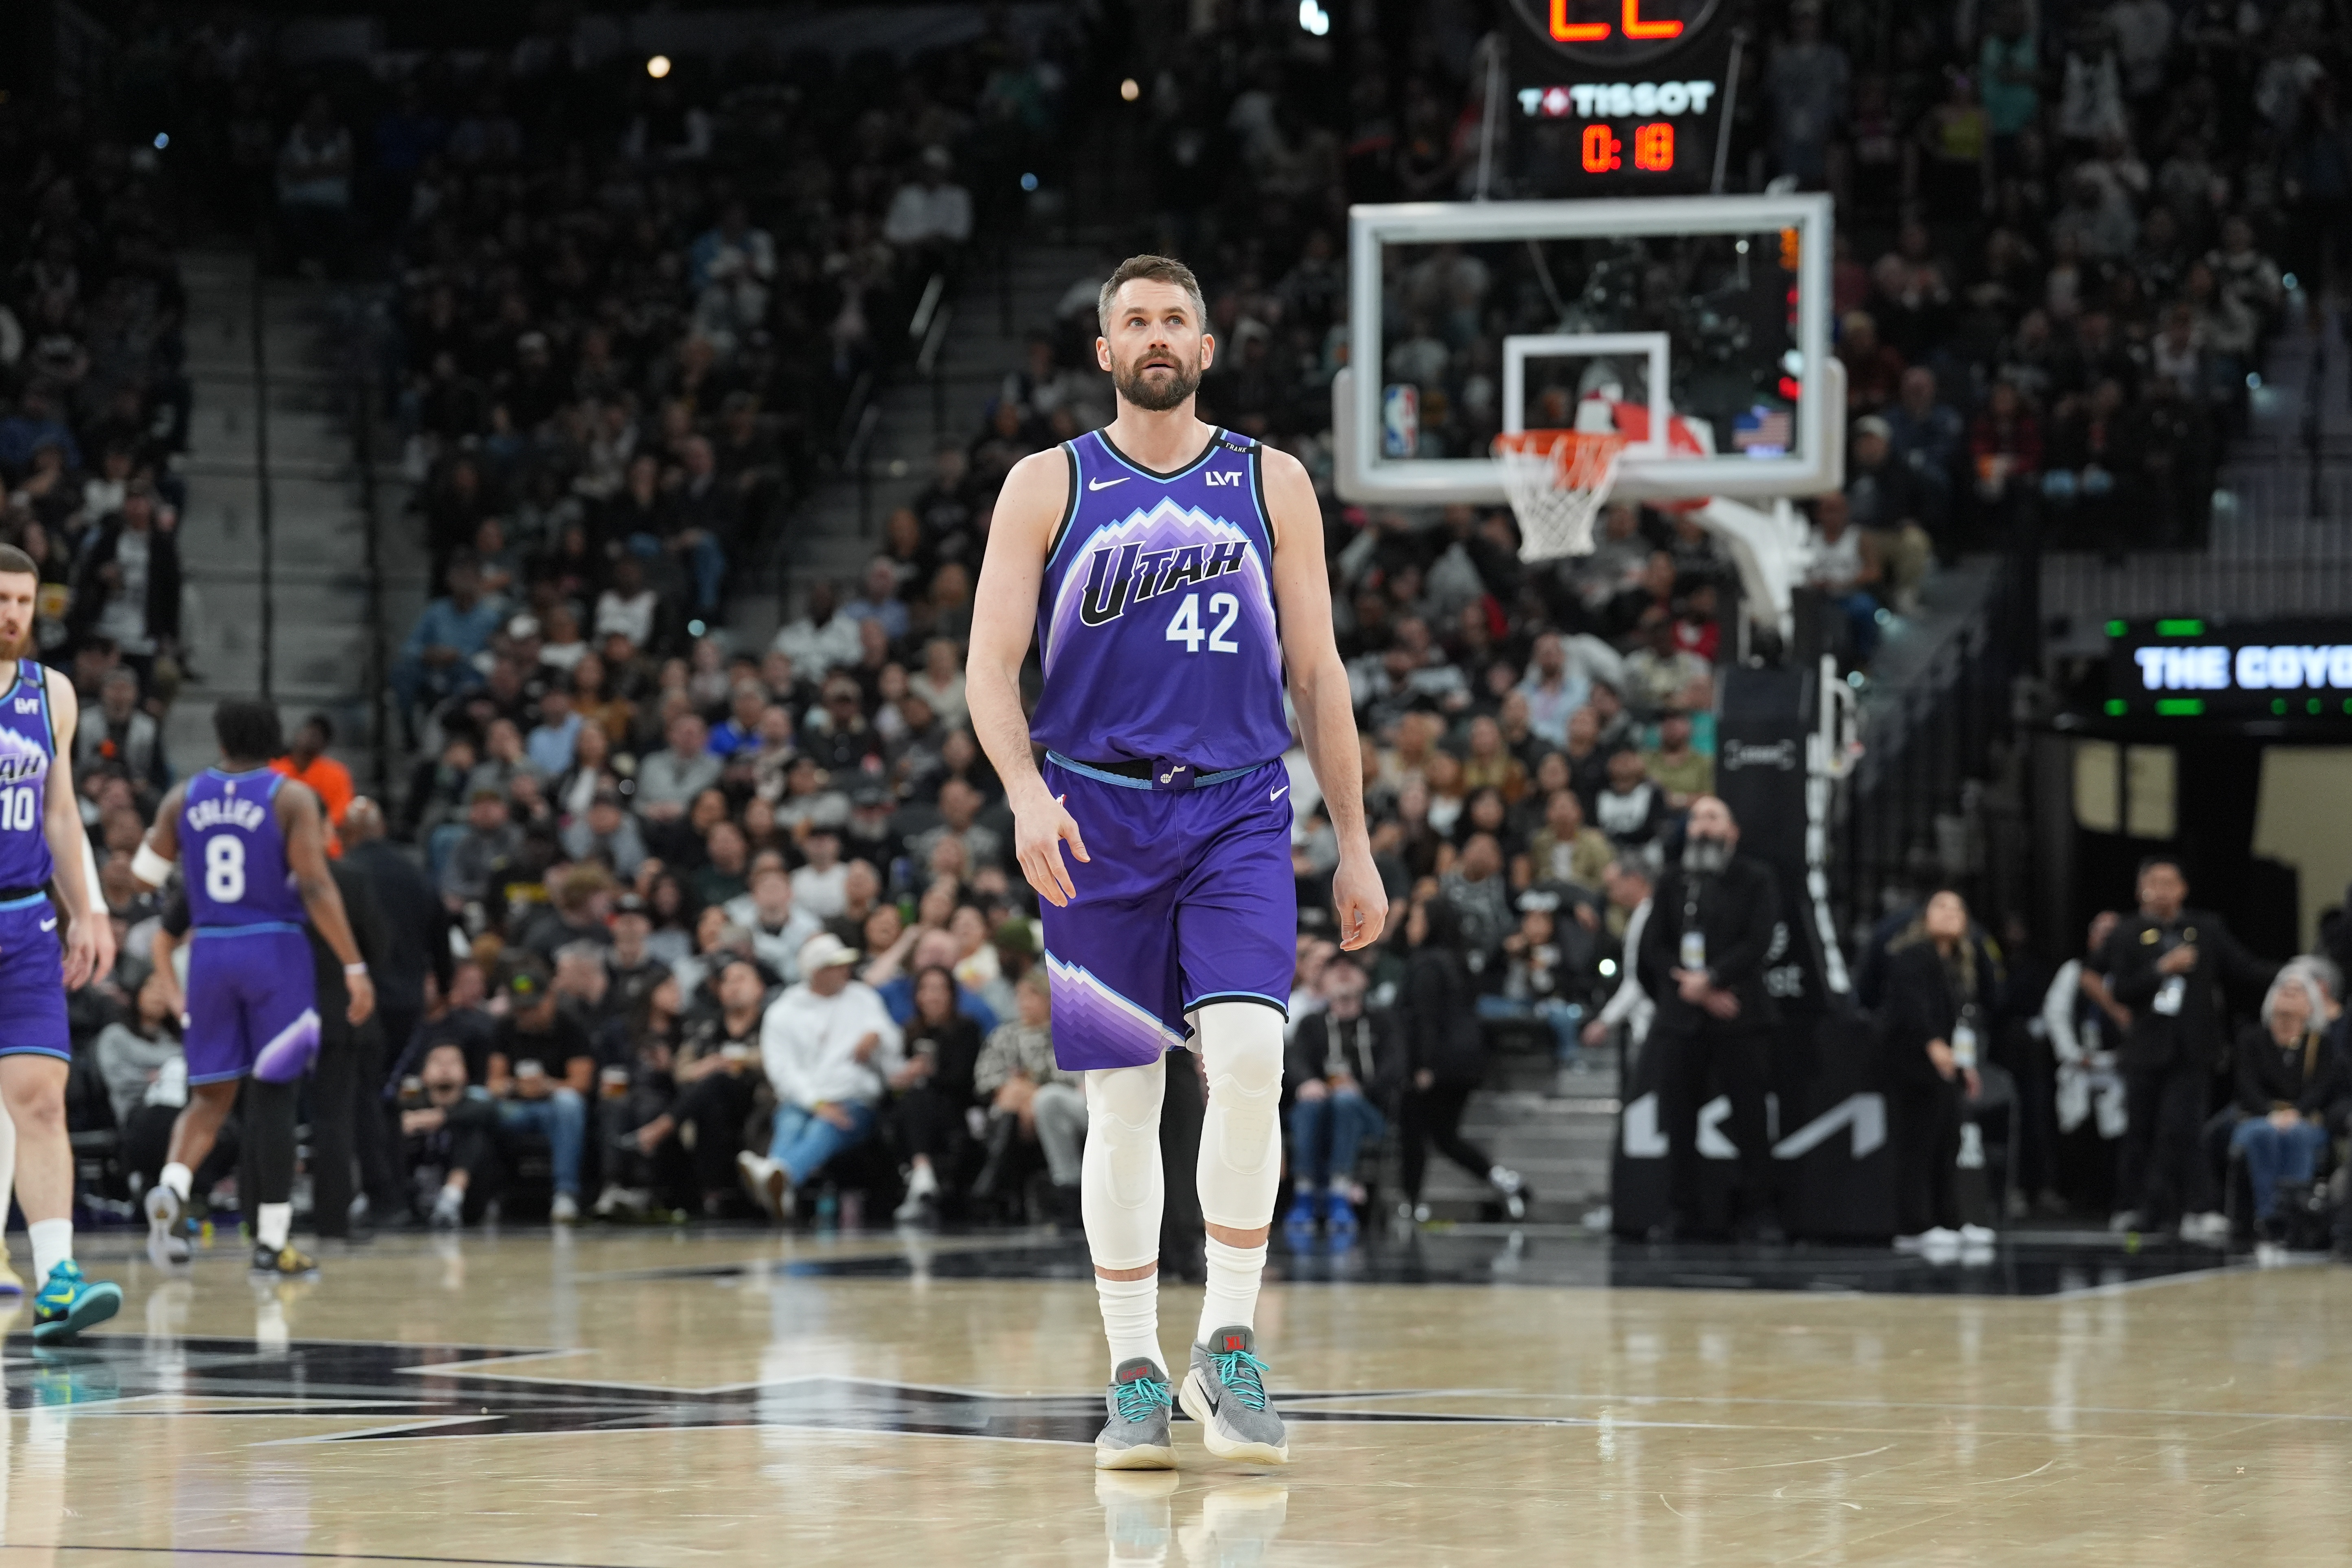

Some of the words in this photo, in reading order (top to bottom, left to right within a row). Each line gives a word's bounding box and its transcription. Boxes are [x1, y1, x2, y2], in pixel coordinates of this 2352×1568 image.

[1570, 81, 1715, 118] TISSOT
[1225, 442, 1247, 452] FRANK
[1205, 471, 1243, 486] LVT
[1080, 539, 1252, 627] UTAH
[1166, 592, 1239, 653] 42
[2135, 646, 2231, 690] THE
[0, 785, 34, 831] 10
[206, 834, 245, 903] 8
[1226, 1336, 1244, 1351] XL
